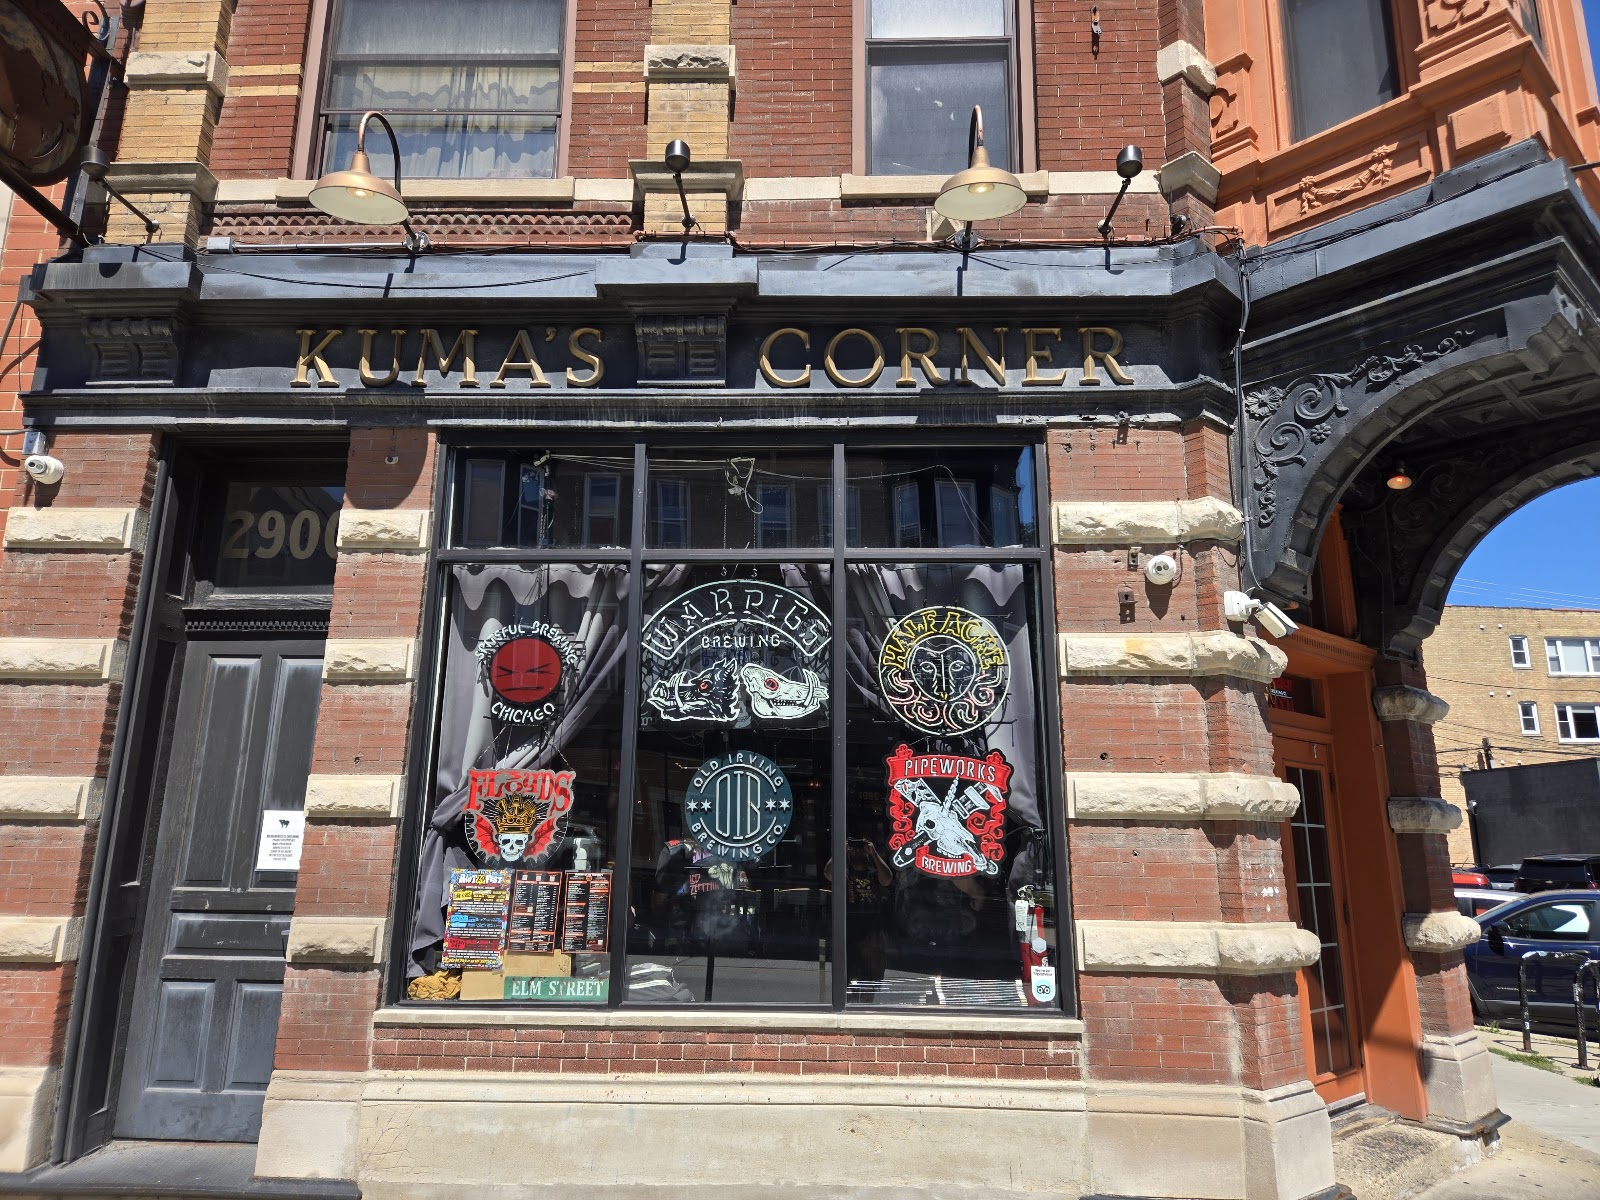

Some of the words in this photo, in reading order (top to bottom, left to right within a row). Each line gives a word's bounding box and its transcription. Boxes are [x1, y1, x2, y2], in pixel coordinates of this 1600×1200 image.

[290, 327, 605, 388] KUMA'S
[759, 327, 1134, 387] CORNER
[646, 588, 827, 650] WARPIGS
[475, 624, 526, 660] SPITEFUL
[531, 620, 578, 665] BREWING
[701, 635, 781, 649] BREWING
[883, 610, 937, 670] HALF
[940, 611, 1004, 670] ACRE
[491, 701, 556, 724] CHICAGO
[693, 760, 719, 788] OLD
[728, 752, 784, 787] IRVING
[904, 758, 996, 782] PIPEWORKS
[463, 770, 573, 816] FLOYDS
[691, 822, 763, 859] BREWING
[766, 823, 787, 844] CO.
[921, 856, 973, 874] BREWING
[511, 980, 541, 996] ELM
[548, 980, 604, 996] STREET
